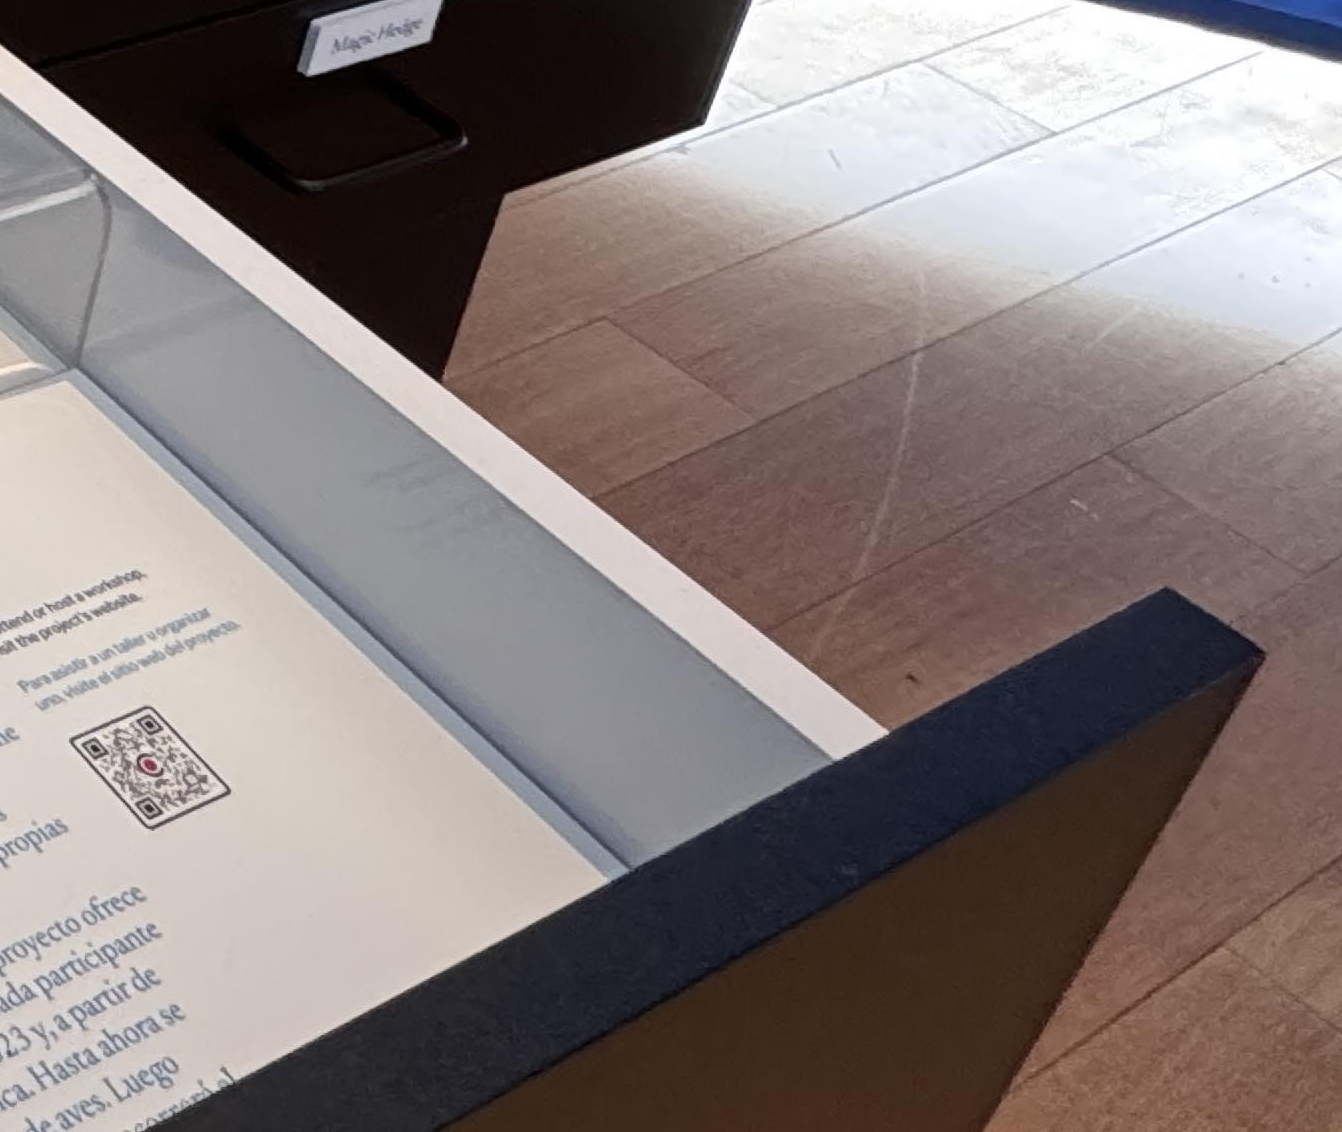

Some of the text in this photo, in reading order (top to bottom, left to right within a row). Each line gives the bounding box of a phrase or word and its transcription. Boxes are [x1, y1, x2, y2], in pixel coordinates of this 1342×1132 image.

[80, 886, 148, 927] ofrece
[32, 923, 163, 1002] participante
[25, 1047, 102, 1092] Hasta
[96, 1015, 165, 1059] ahora
[158, 1003, 186, 1027] se
[28, 1021, 60, 1052] y,
[66, 978, 133, 1033] partir
[129, 966, 162, 994] de
[54, 1093, 113, 1129] aves.
[100, 1056, 180, 1104] Luego
